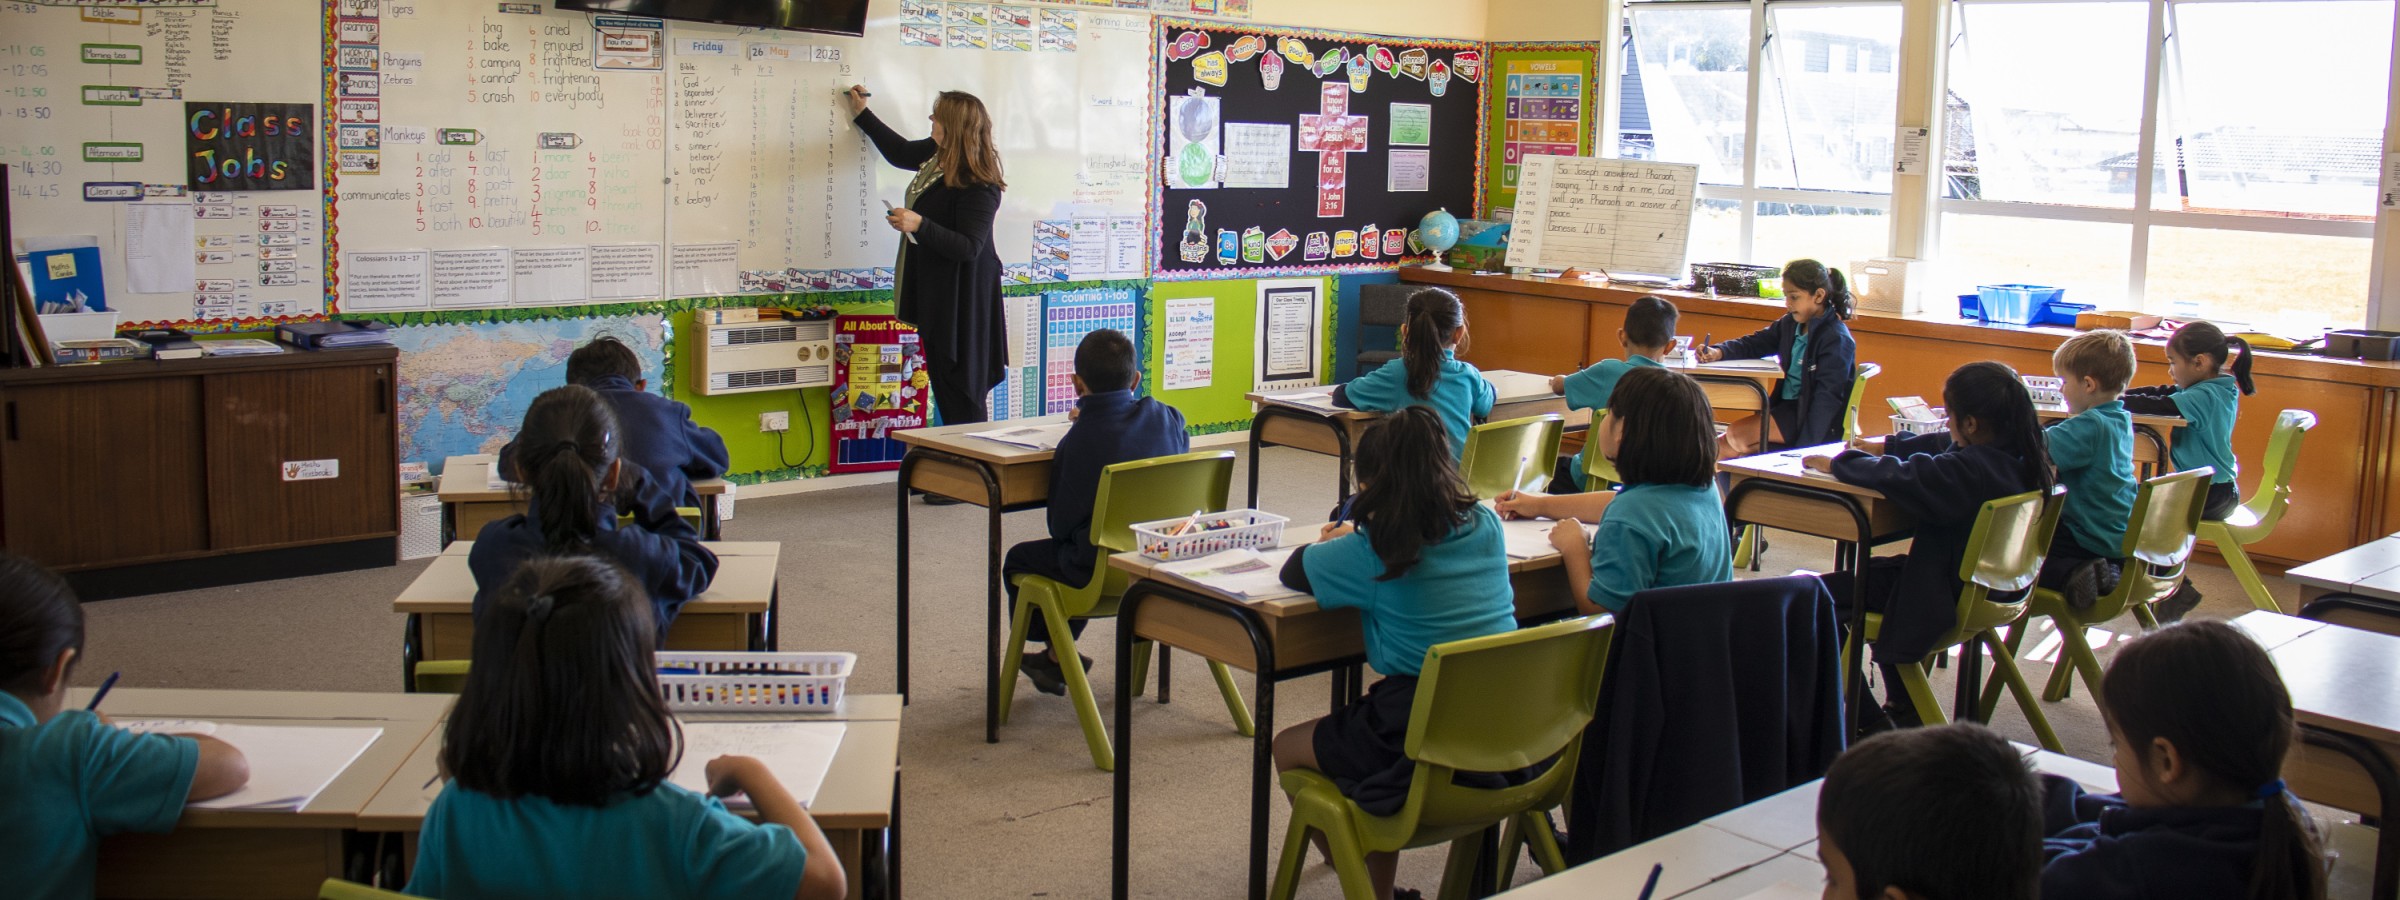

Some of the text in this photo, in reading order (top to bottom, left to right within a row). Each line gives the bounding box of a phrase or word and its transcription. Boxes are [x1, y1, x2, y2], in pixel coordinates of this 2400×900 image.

[92, 8, 115, 17] Bible
[386, 0, 414, 18] Tigers
[544, 19, 570, 36] cried
[1088, 16, 1120, 27] Warning
[483, 16, 502, 40] bag
[483, 35, 510, 52] bake
[544, 36, 584, 57] enjoyed
[693, 42, 723, 53] Friday
[1181, 40, 1194, 50] God
[1234, 43, 1257, 54] wanted
[86, 49, 127, 59] Morning tea
[752, 47, 840, 60] 26 May 2023
[1288, 46, 1303, 57] good
[383, 51, 422, 70] Penguins
[542, 50, 592, 72] frightened
[1322, 55, 1340, 68] things
[1403, 55, 1425, 64] planned
[1455, 58, 1478, 66] Ephesians
[481, 59, 520, 75] camping
[1411, 65, 1421, 73] for
[1464, 66, 1475, 75] 2:10
[1530, 63, 1556, 71] VOWELS
[383, 74, 413, 85] Zebras
[481, 73, 517, 84] cannot
[543, 68, 600, 92] frightening
[1201, 70, 1222, 78] always
[683, 76, 699, 89] God
[1509, 79, 1518, 91] A
[98, 90, 126, 101] Lunch
[482, 86, 515, 103] crash
[545, 86, 604, 110] everybody
[684, 86, 714, 99] separated
[1327, 105, 1342, 113] what
[1509, 102, 1516, 114] E
[685, 110, 718, 119] Deliverer
[191, 108, 302, 140] Class
[1302, 125, 1315, 133] love
[384, 127, 425, 144] Monkeys
[1325, 132, 1342, 141] Jesus
[1351, 126, 1366, 135] gave
[1355, 135, 1363, 143] his
[89, 147, 124, 157] Afternoon
[485, 142, 509, 162] last
[689, 143, 712, 151] sinner
[428, 148, 451, 163] cold
[690, 153, 715, 161] believe
[1506, 148, 1515, 160] O
[195, 147, 288, 183] Jobs
[1086, 153, 1126, 169] Unfinished
[1328, 157, 1338, 165] life
[429, 162, 456, 177] after
[483, 164, 510, 180] only
[689, 162, 711, 174] loved
[1323, 165, 1332, 173] for
[1558, 164, 1568, 175] So
[1575, 161, 1599, 181] Joseph
[1604, 168, 1639, 179] answered
[695, 177, 706, 185] no
[1507, 169, 1514, 181] U
[89, 187, 127, 197] Clean up
[428, 179, 450, 195] old
[485, 180, 514, 197] past
[1603, 183, 1609, 191] is
[1613, 184, 1625, 192] not
[1658, 184, 1675, 196] God
[341, 189, 411, 201] communicates
[429, 197, 454, 212] fast
[484, 195, 517, 214] pretty
[1552, 195, 1565, 205] will
[1570, 196, 1584, 208] give
[1591, 194, 1621, 206] Pharaoh
[1640, 202, 1666, 210] answer
[1671, 199, 1681, 211] of
[433, 213, 462, 231] both
[488, 211, 526, 228] beautiful
[1548, 220, 1577, 233] Genesis
[1224, 240, 1234, 249] Be
[1248, 240, 1260, 248] kind
[1269, 238, 1292, 246] merciful
[1365, 239, 1376, 248] just
[875, 276, 893, 285] bright
[1062, 291, 1128, 303] COUNTING 1-100
[843, 321, 887, 330] All About
